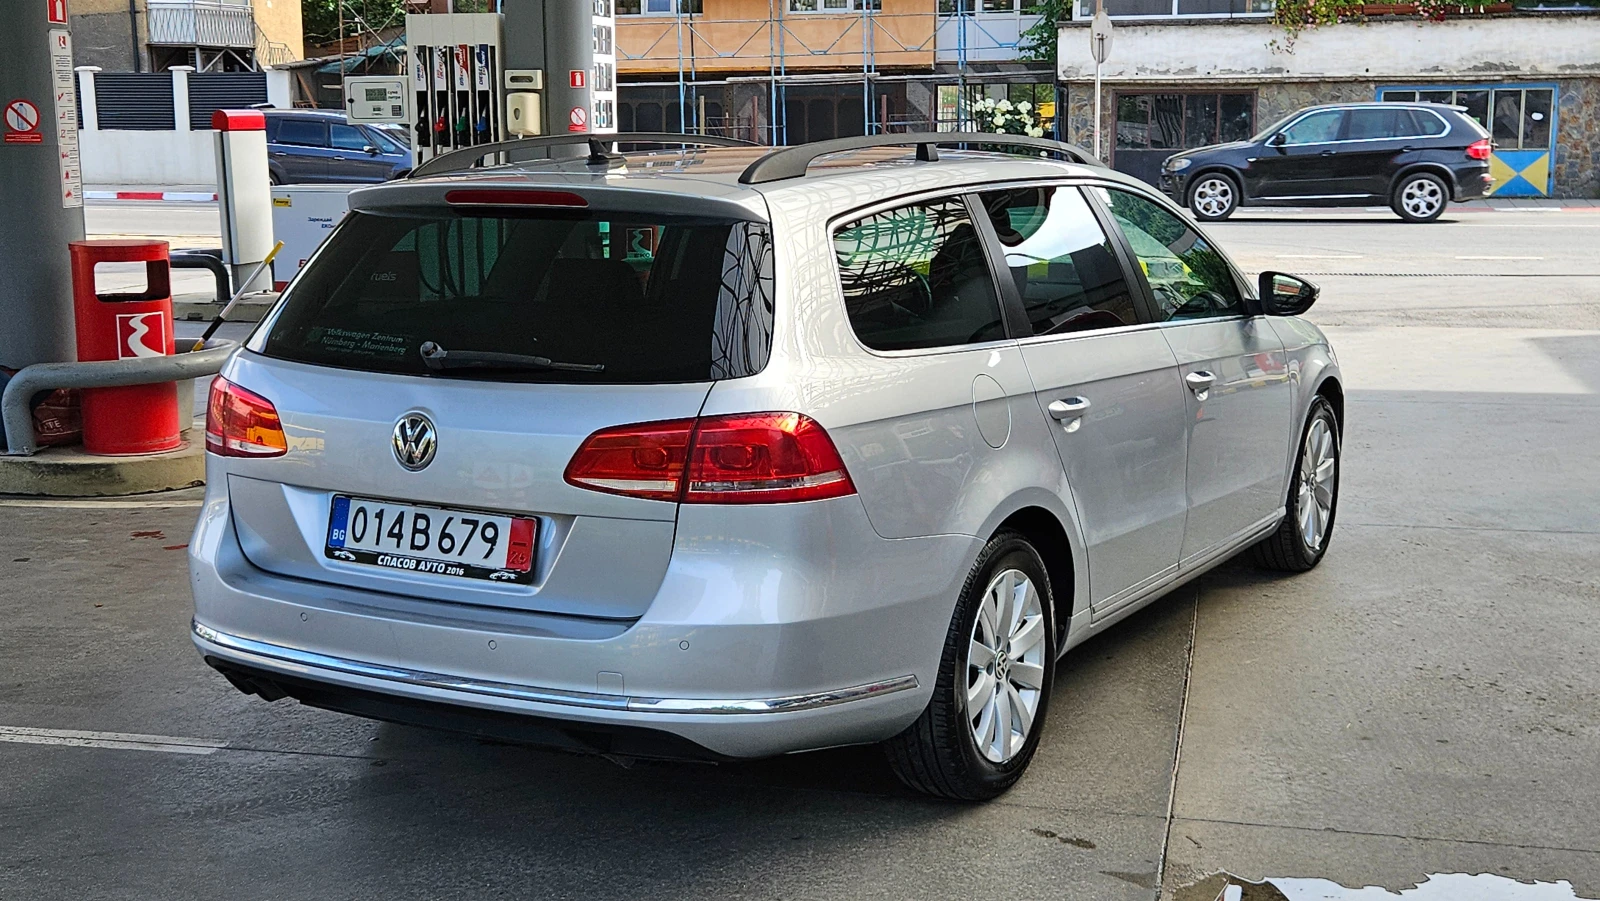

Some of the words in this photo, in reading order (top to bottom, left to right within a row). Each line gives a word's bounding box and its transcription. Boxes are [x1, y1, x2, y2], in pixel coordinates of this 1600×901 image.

[326, 328, 371, 340] Volkswagen
[371, 332, 404, 343] Zentrum
[361, 340, 407, 355] Marienberg
[332, 528, 345, 541] BG
[352, 506, 499, 559] 014B679
[377, 555, 416, 570] СПАСОВ
[417, 560, 446, 573] АУТО
[446, 567, 464, 576] 2016
